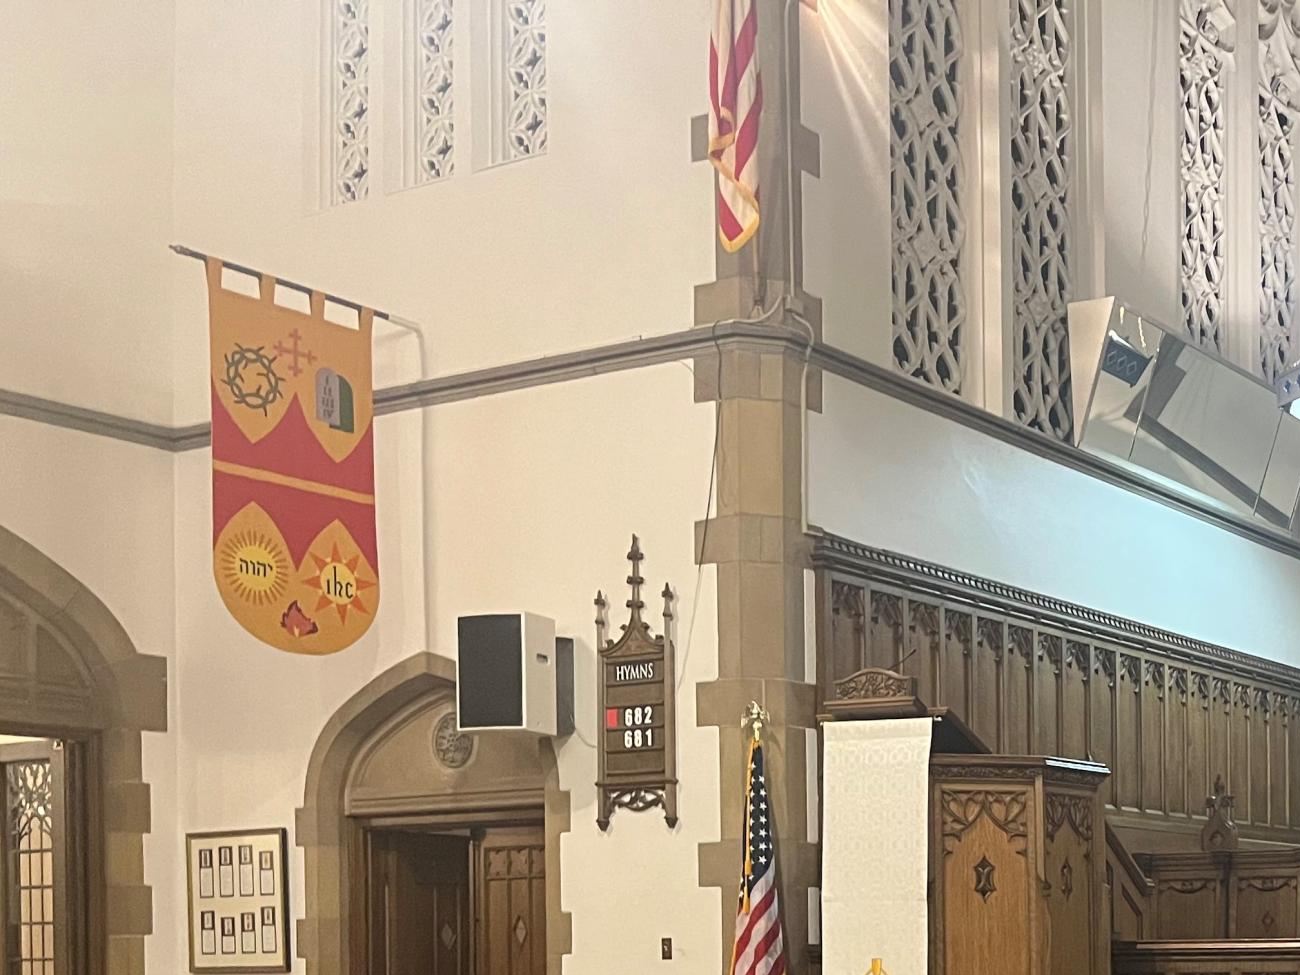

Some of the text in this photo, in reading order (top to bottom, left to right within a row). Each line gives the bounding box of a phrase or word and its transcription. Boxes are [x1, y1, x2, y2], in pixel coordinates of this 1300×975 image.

[616, 662, 654, 681] HYMNS
[624, 706, 653, 727] 682
[624, 728, 653, 748] 681
